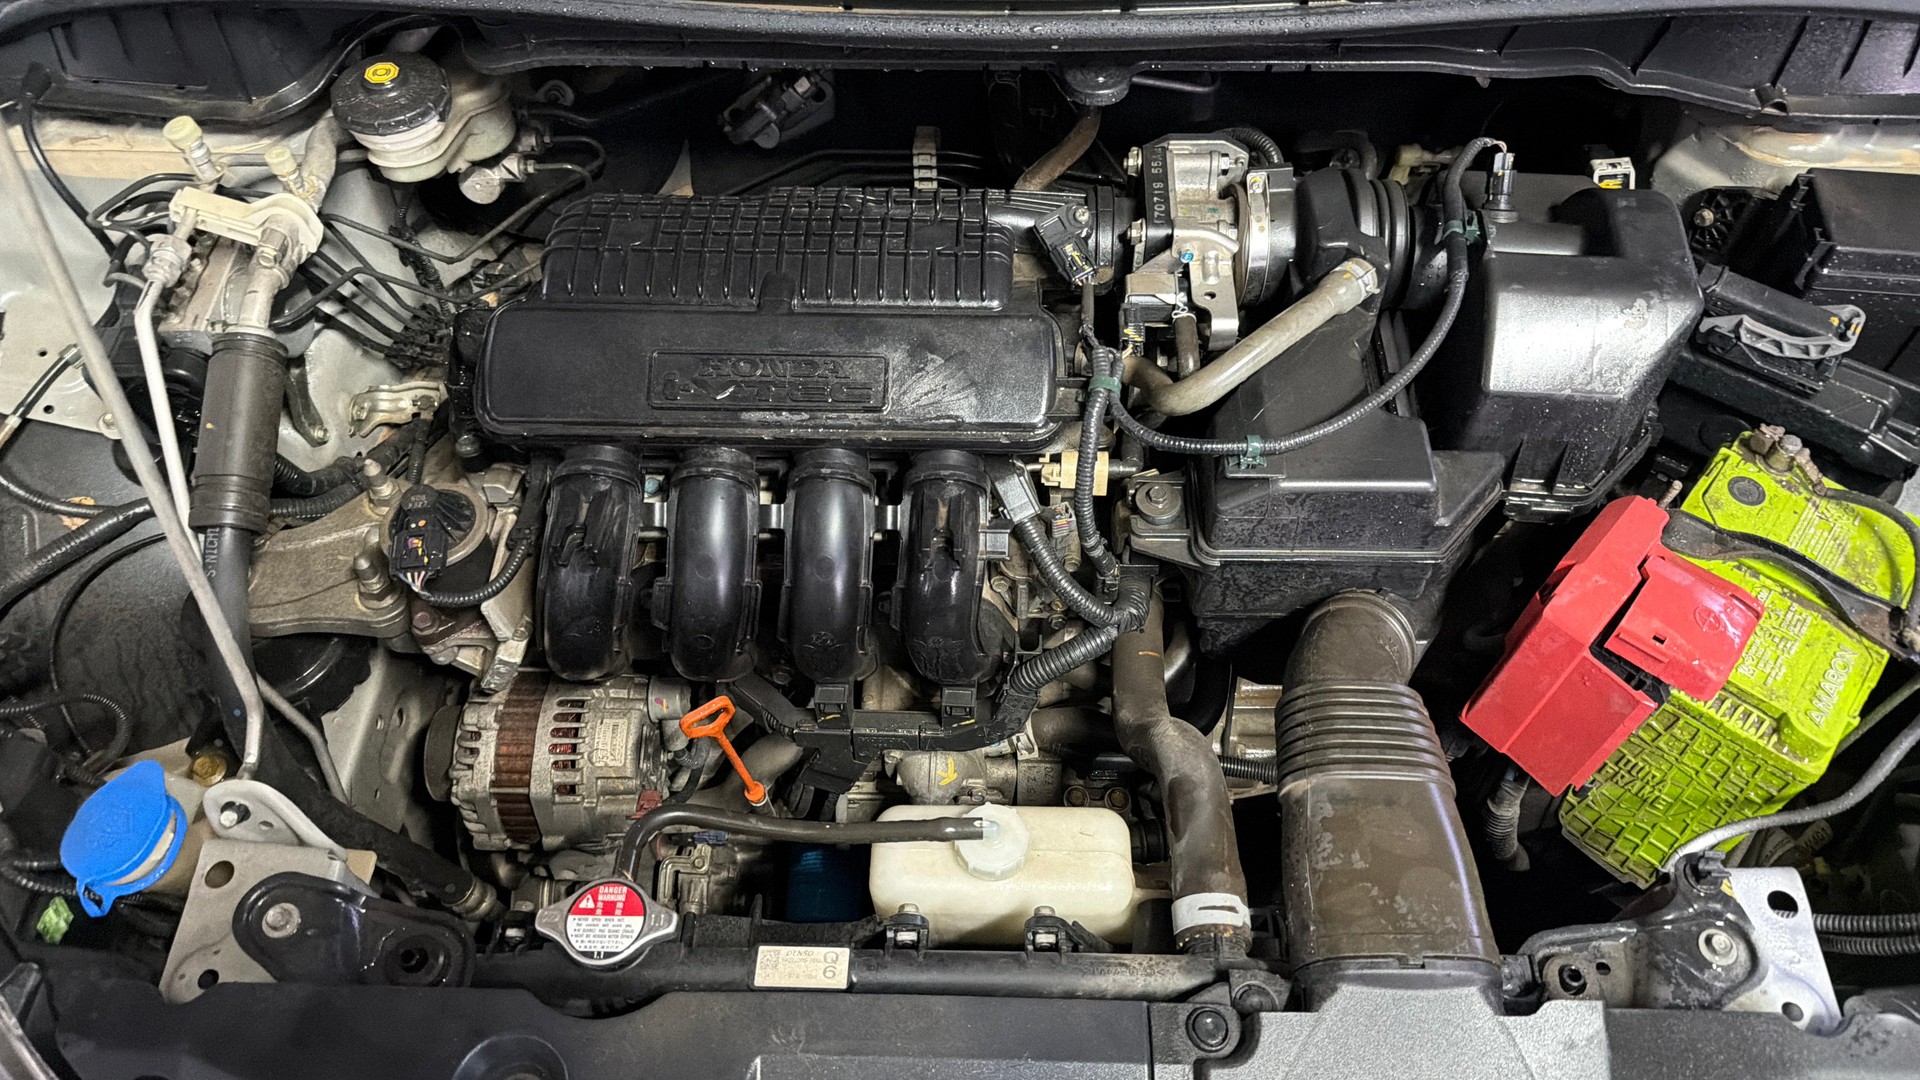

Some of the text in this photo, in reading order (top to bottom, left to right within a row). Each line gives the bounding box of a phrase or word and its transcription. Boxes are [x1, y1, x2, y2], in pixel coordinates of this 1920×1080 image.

[698, 357, 851, 379] HONDA
[1805, 644, 1859, 728] AMARON
[1597, 760, 1674, 810] FRAME
[1616, 754, 1671, 794] DURA
[598, 886, 627, 894] DANGER
[823, 950, 839, 965] Q
[823, 965, 838, 979] 6
